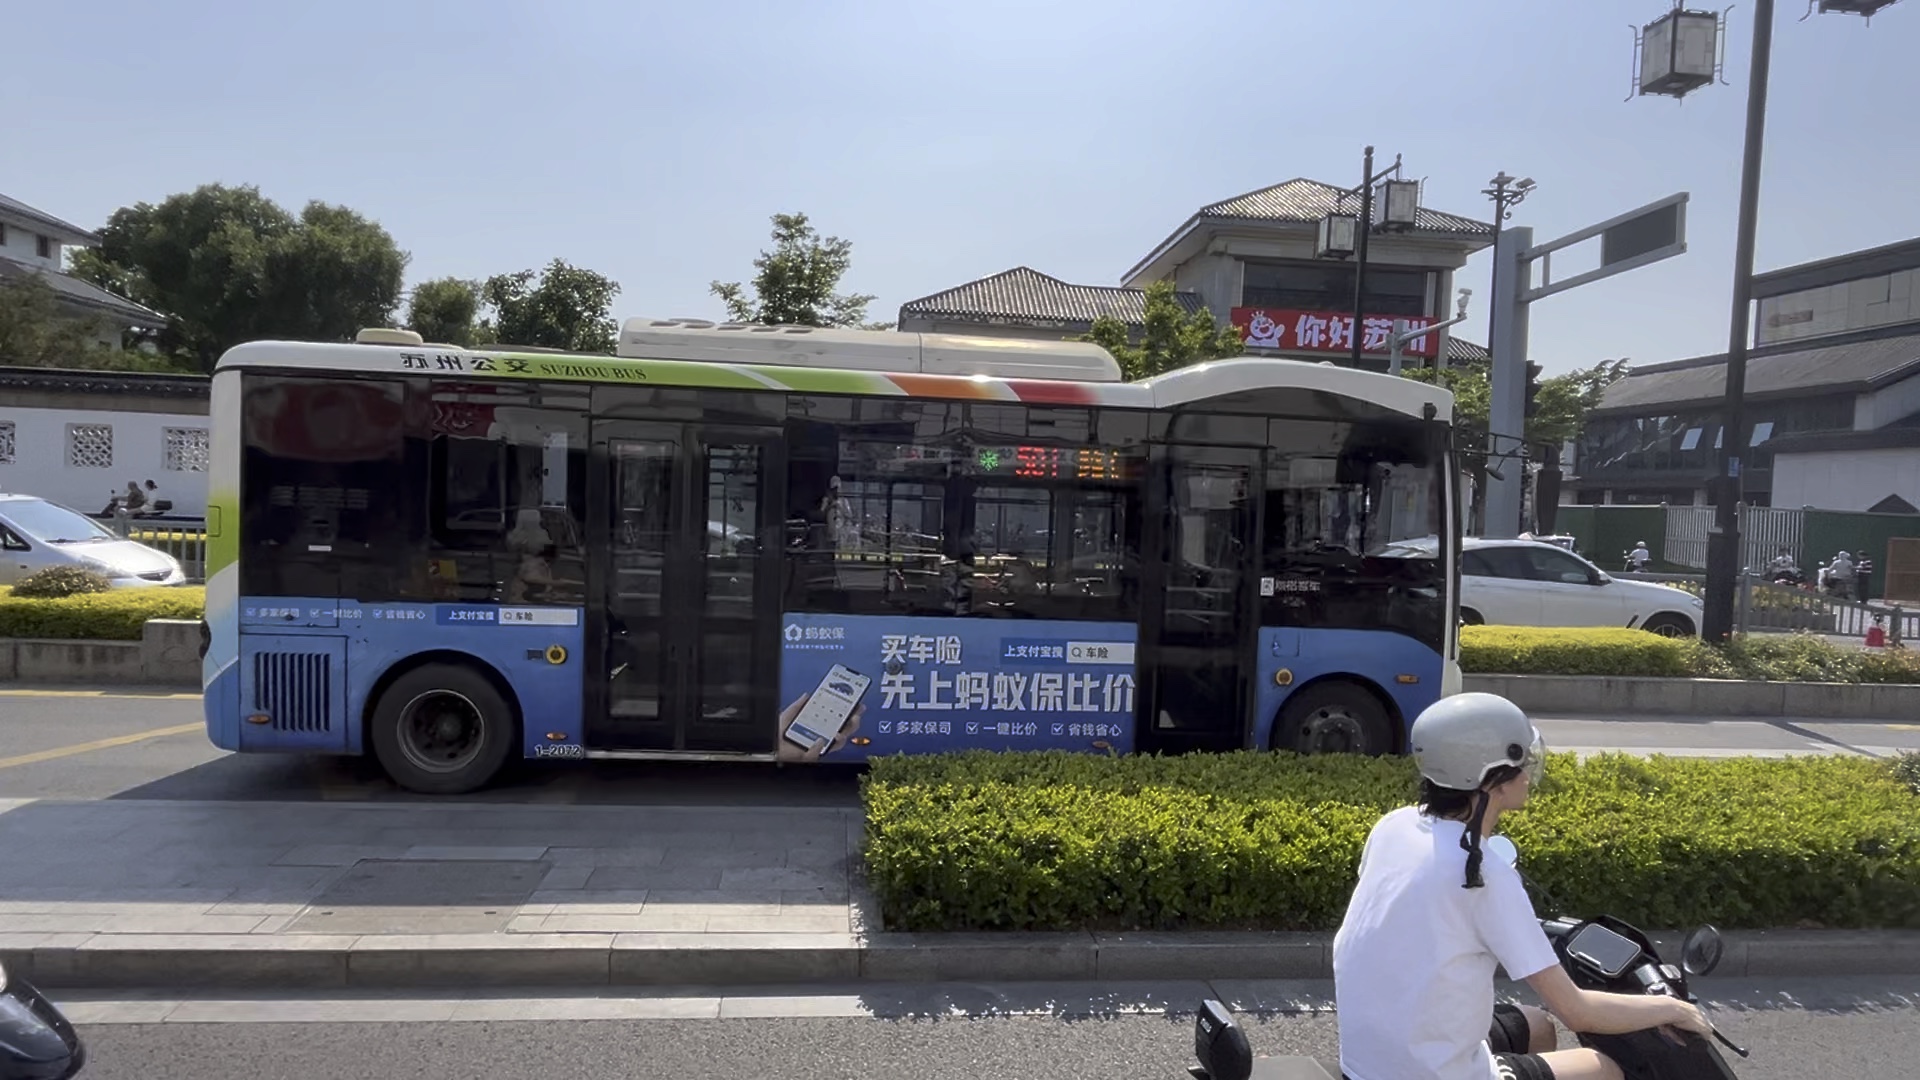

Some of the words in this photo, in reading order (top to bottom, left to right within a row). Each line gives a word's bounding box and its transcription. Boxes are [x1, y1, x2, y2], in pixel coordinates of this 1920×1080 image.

[400, 353, 532, 374] 苏州公交
[540, 363, 610, 378] SUZHOU
[613, 367, 647, 380] BUS
[805, 627, 845, 640] 蚂蚁保
[881, 634, 962, 665] 买车险
[1004, 645, 1064, 660] 上支付宝搜
[1086, 646, 1109, 660] 车险
[880, 670, 1136, 713] 先上蚂蚁保比价
[896, 721, 952, 736] 多家保司
[983, 722, 1038, 737] 一键比价
[1068, 723, 1122, 737] 省钱省心
